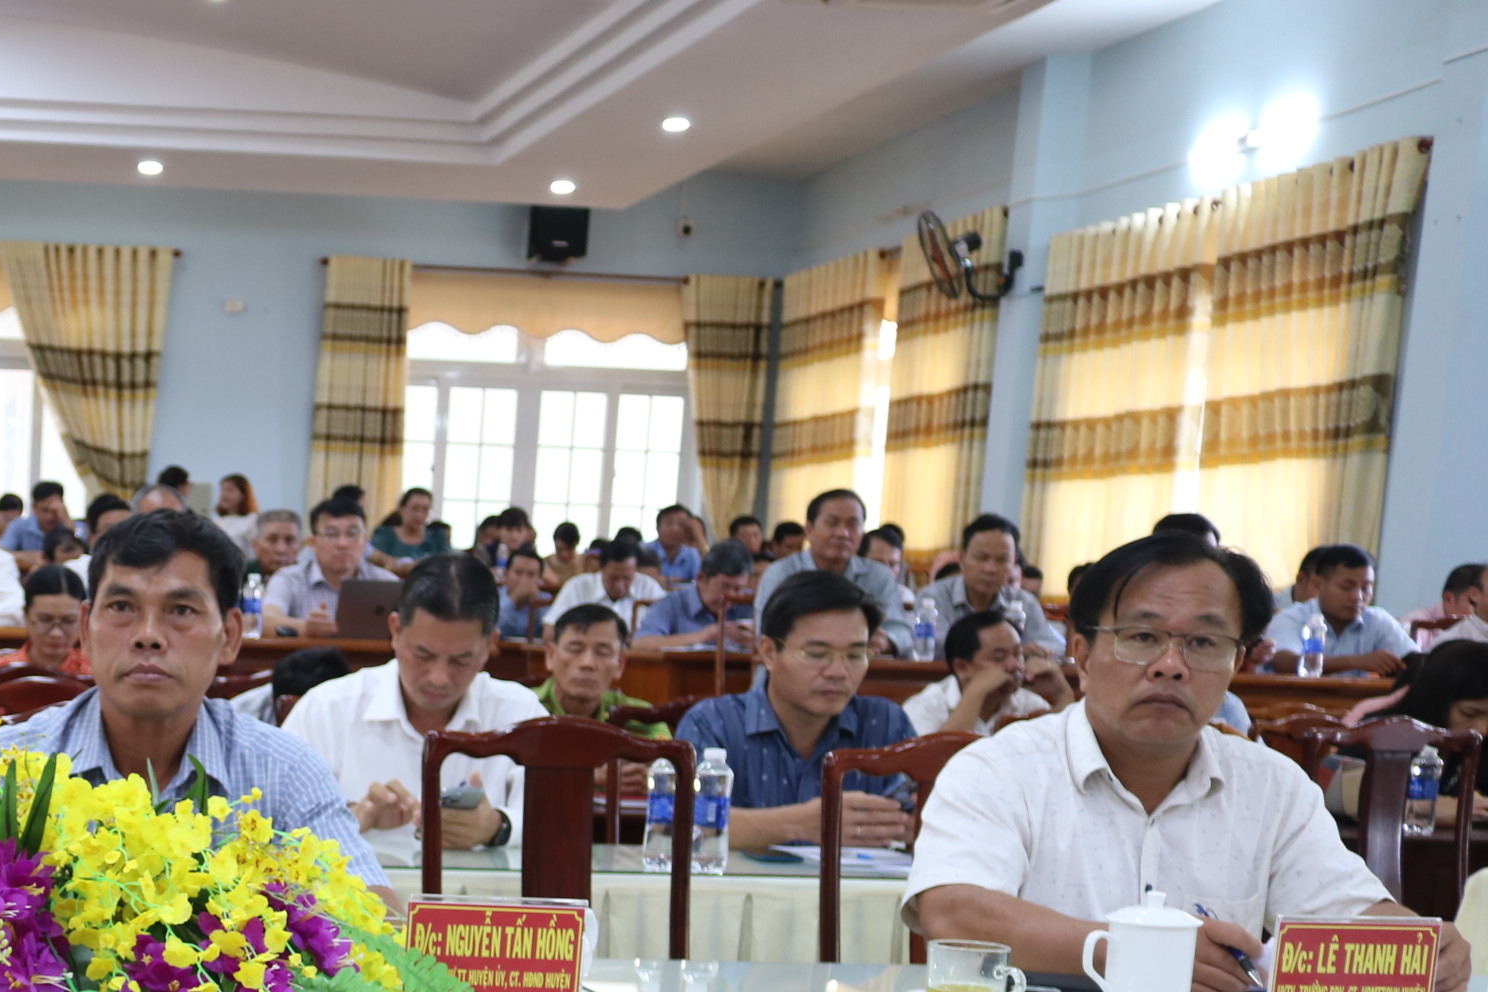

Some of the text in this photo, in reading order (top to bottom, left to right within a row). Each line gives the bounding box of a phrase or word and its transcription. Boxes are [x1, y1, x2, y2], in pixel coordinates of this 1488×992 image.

[415, 909, 575, 961] Đ/c: NGUYỄN TẤN HỒNG
[1281, 933, 1429, 976] Đ/c: LÊ THANH HẢI
[468, 966, 494, 990] HUYỆN
[545, 968, 571, 992] HUYỆN
